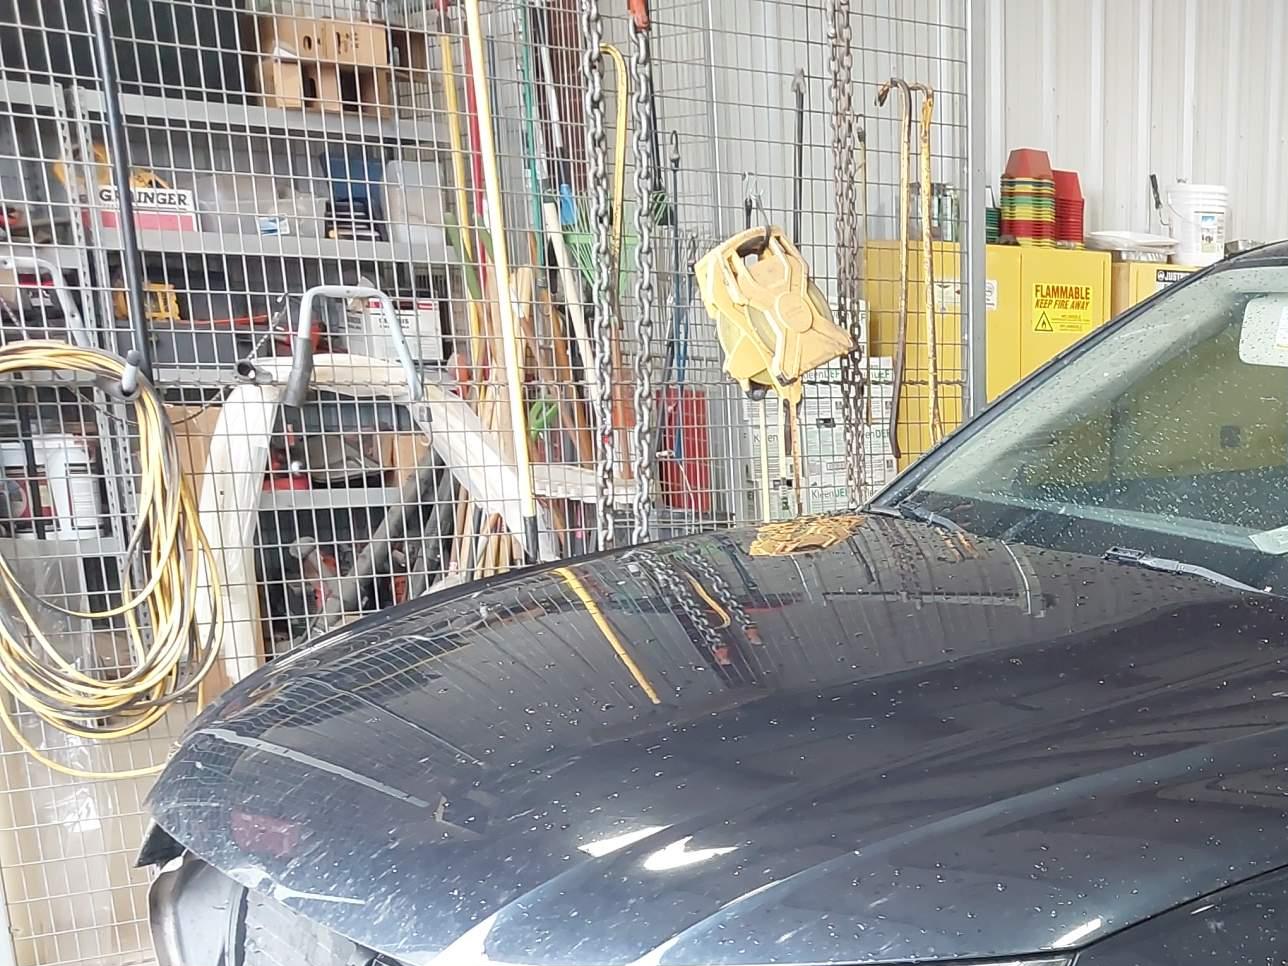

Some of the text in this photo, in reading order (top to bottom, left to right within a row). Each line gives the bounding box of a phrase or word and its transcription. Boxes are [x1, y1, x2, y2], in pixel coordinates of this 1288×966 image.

[99, 188, 188, 206] GINGER
[1034, 284, 1091, 300] FLAMMABLE
[1034, 299, 1091, 311] KEEP FIRE AWAY
